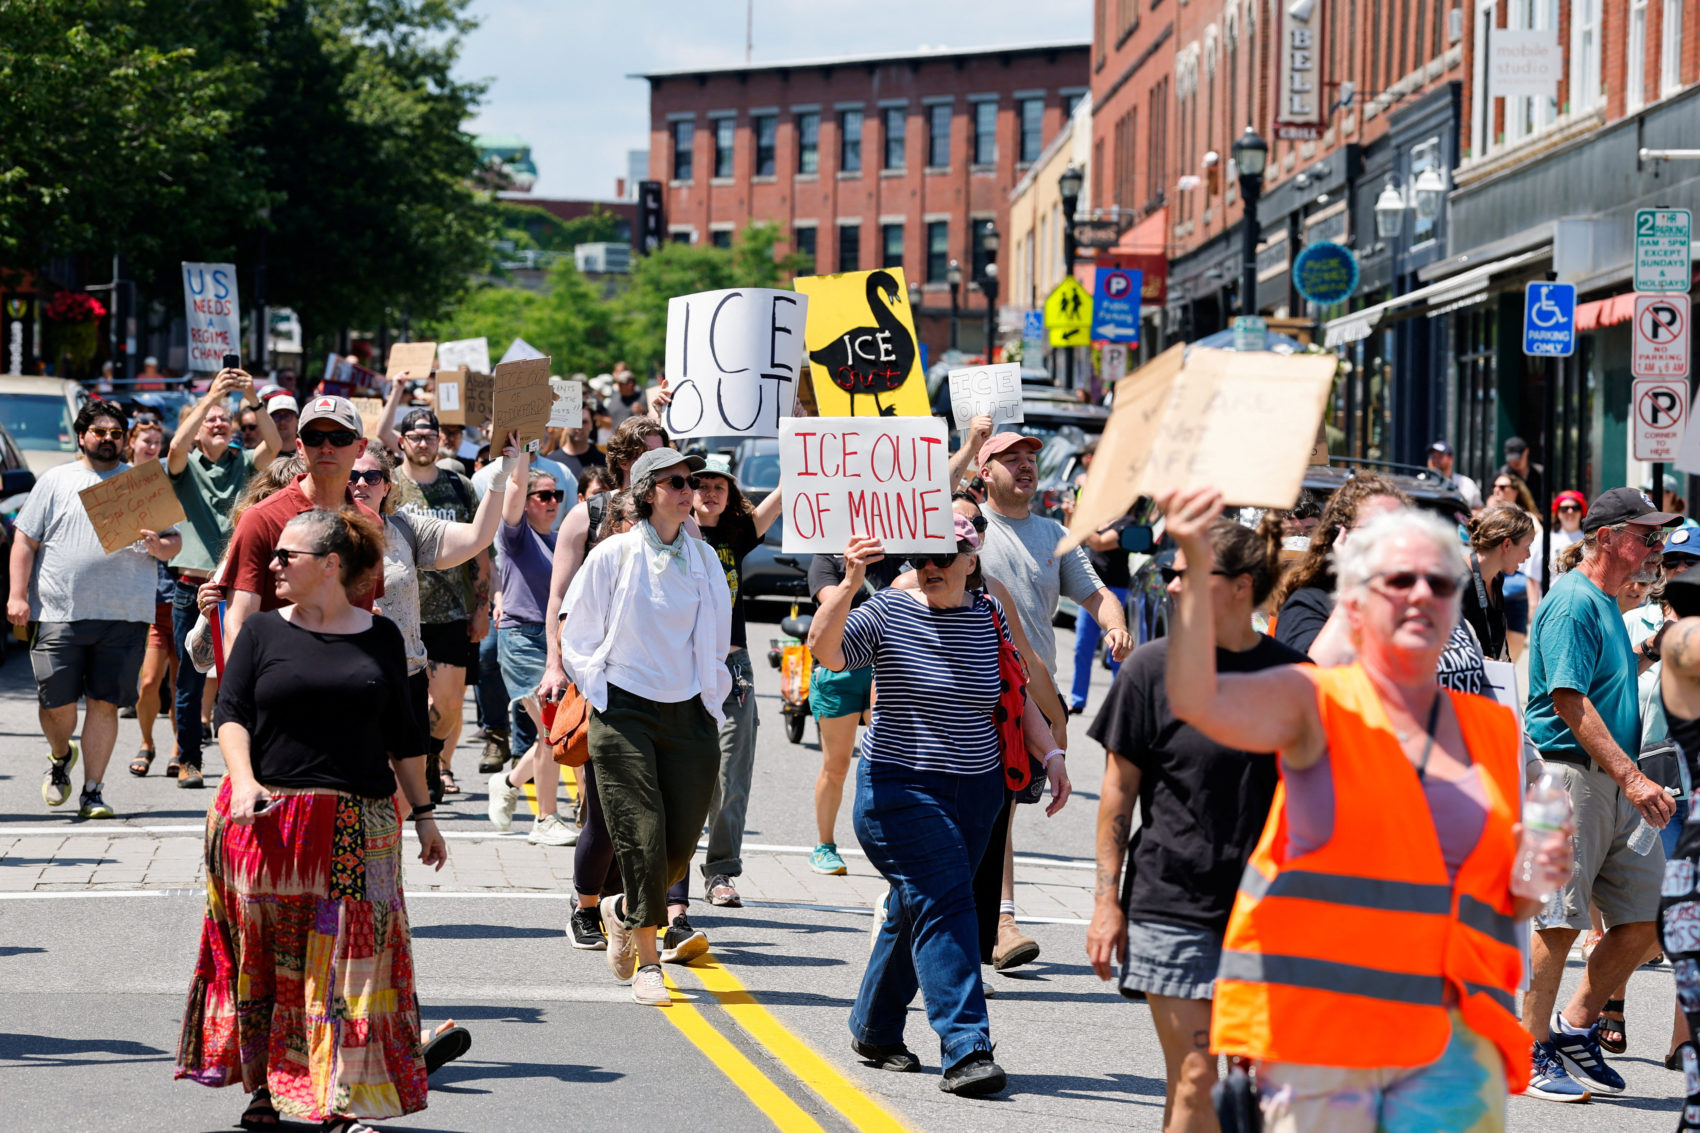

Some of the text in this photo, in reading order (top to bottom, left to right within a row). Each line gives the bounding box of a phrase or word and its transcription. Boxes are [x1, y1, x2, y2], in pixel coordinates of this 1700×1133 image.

[1498, 61, 1548, 74] studio
[1640, 215, 1653, 234] 2
[1644, 249, 1681, 257] EXCEPT
[1640, 259, 1685, 267] SUNDAYS
[187, 269, 229, 299] US
[193, 299, 231, 316] NEEDS
[207, 317, 215, 329] A
[191, 327, 231, 346] REGIME
[683, 292, 797, 377] ICE
[1528, 330, 1570, 341] PARKING
[844, 330, 897, 365] ICE
[1533, 342, 1563, 352] ONLY
[952, 371, 1015, 401] ICE
[667, 373, 792, 434] OUT
[957, 400, 1019, 422] OUT
[794, 432, 942, 483] ICE OUT
[793, 488, 945, 540] OF MAINE
